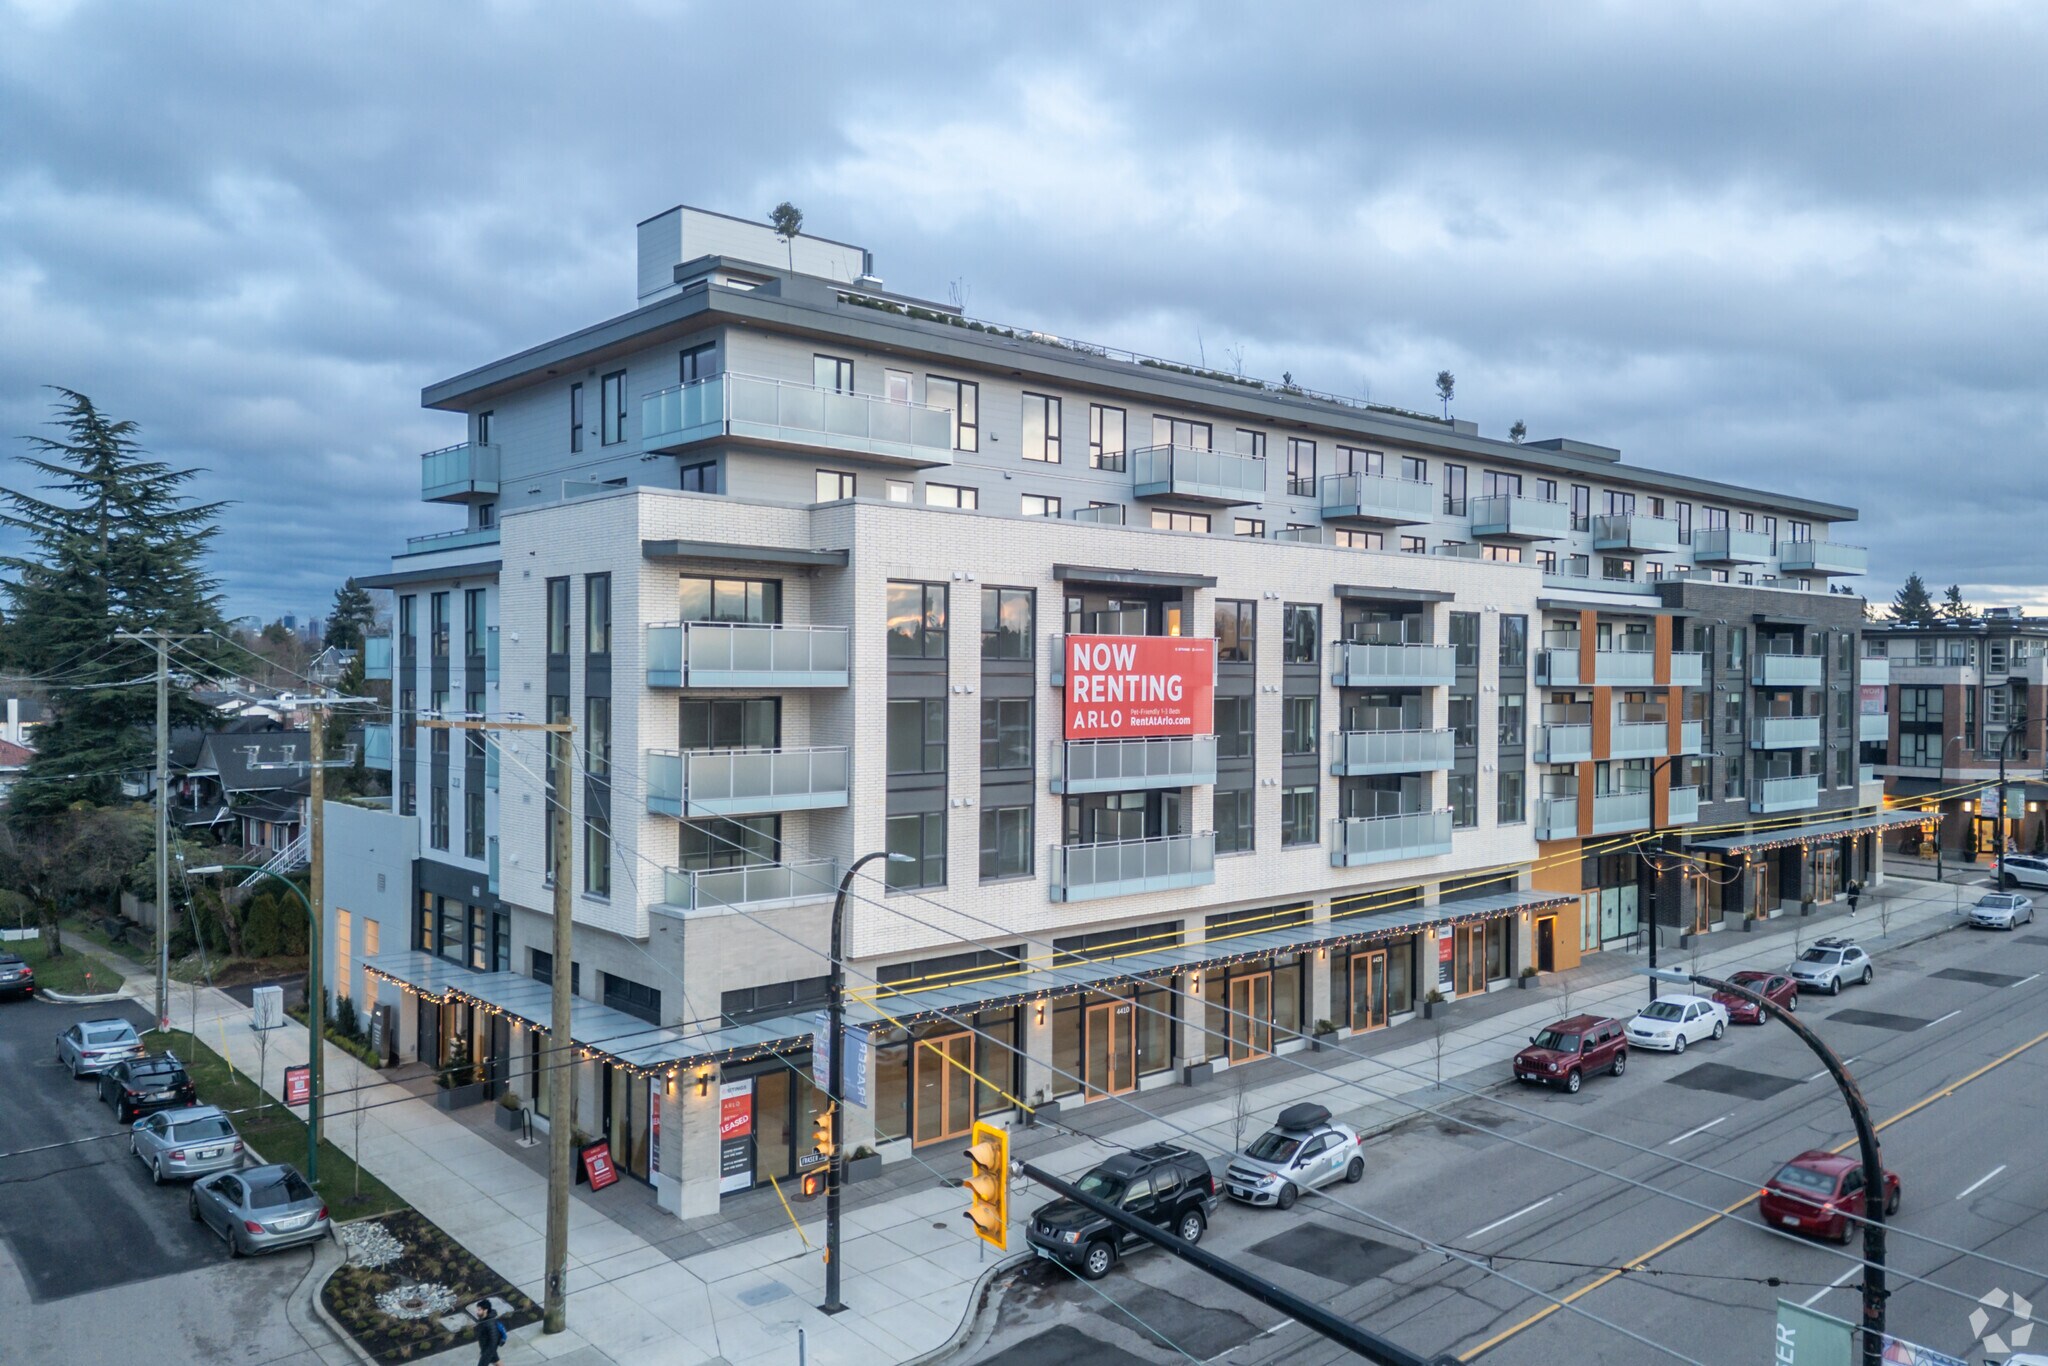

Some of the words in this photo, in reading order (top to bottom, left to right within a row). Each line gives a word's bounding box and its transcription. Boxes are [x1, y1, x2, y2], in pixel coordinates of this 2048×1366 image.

[1073, 643, 1137, 671] NOW
[1073, 675, 1182, 703] RENTING
[1073, 709, 1122, 729] ARLO
[1130, 715, 1191, 726] RentAtArlo.com
[1116, 1006, 1130, 1015] 4410
[721, 1115, 749, 1134] LEASED
[1775, 1323, 1796, 1366] ER
